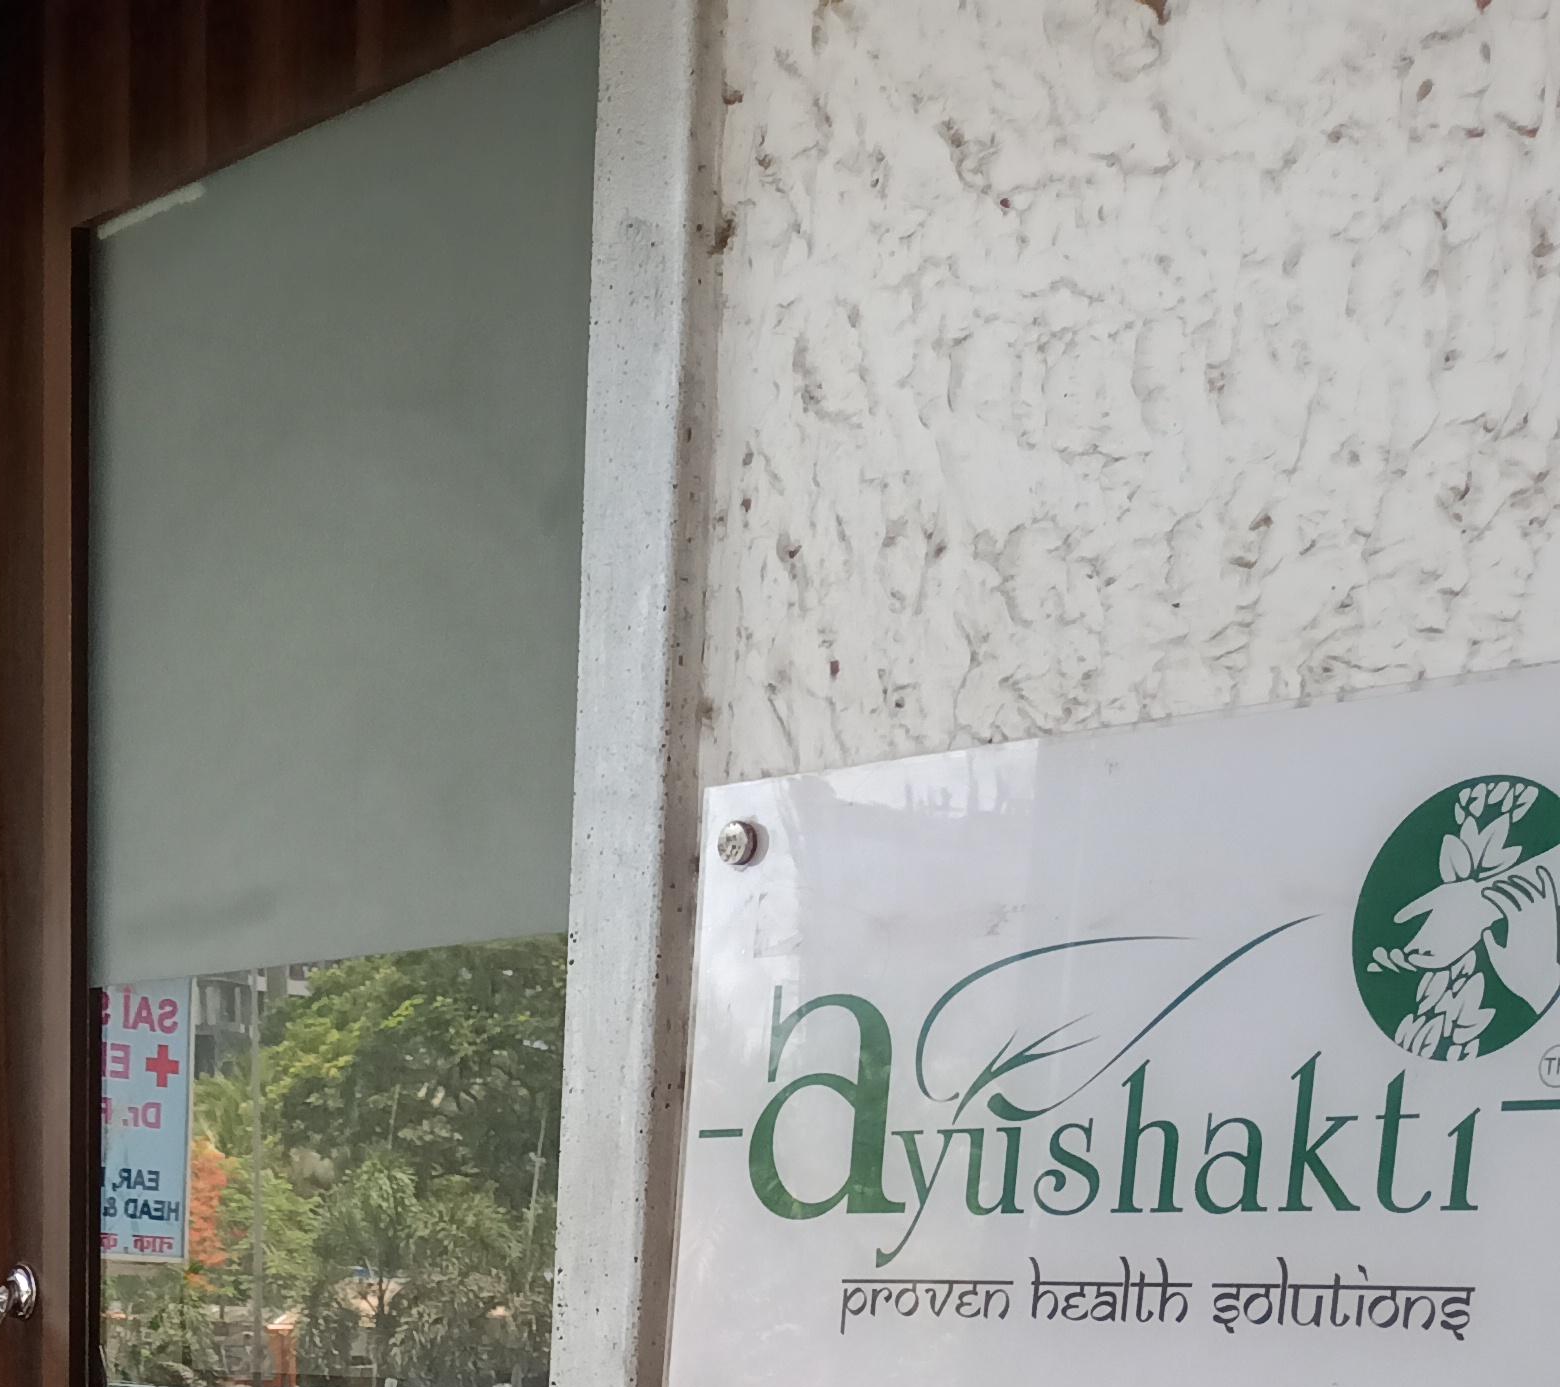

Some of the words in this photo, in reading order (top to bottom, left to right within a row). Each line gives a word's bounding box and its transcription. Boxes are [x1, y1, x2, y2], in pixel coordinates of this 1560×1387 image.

[748, 985, 1482, 1267] ayushakti
[841, 1278, 1014, 1335] proven
[1029, 1257, 1193, 1326] health
[1211, 1257, 1476, 1340] solutions
